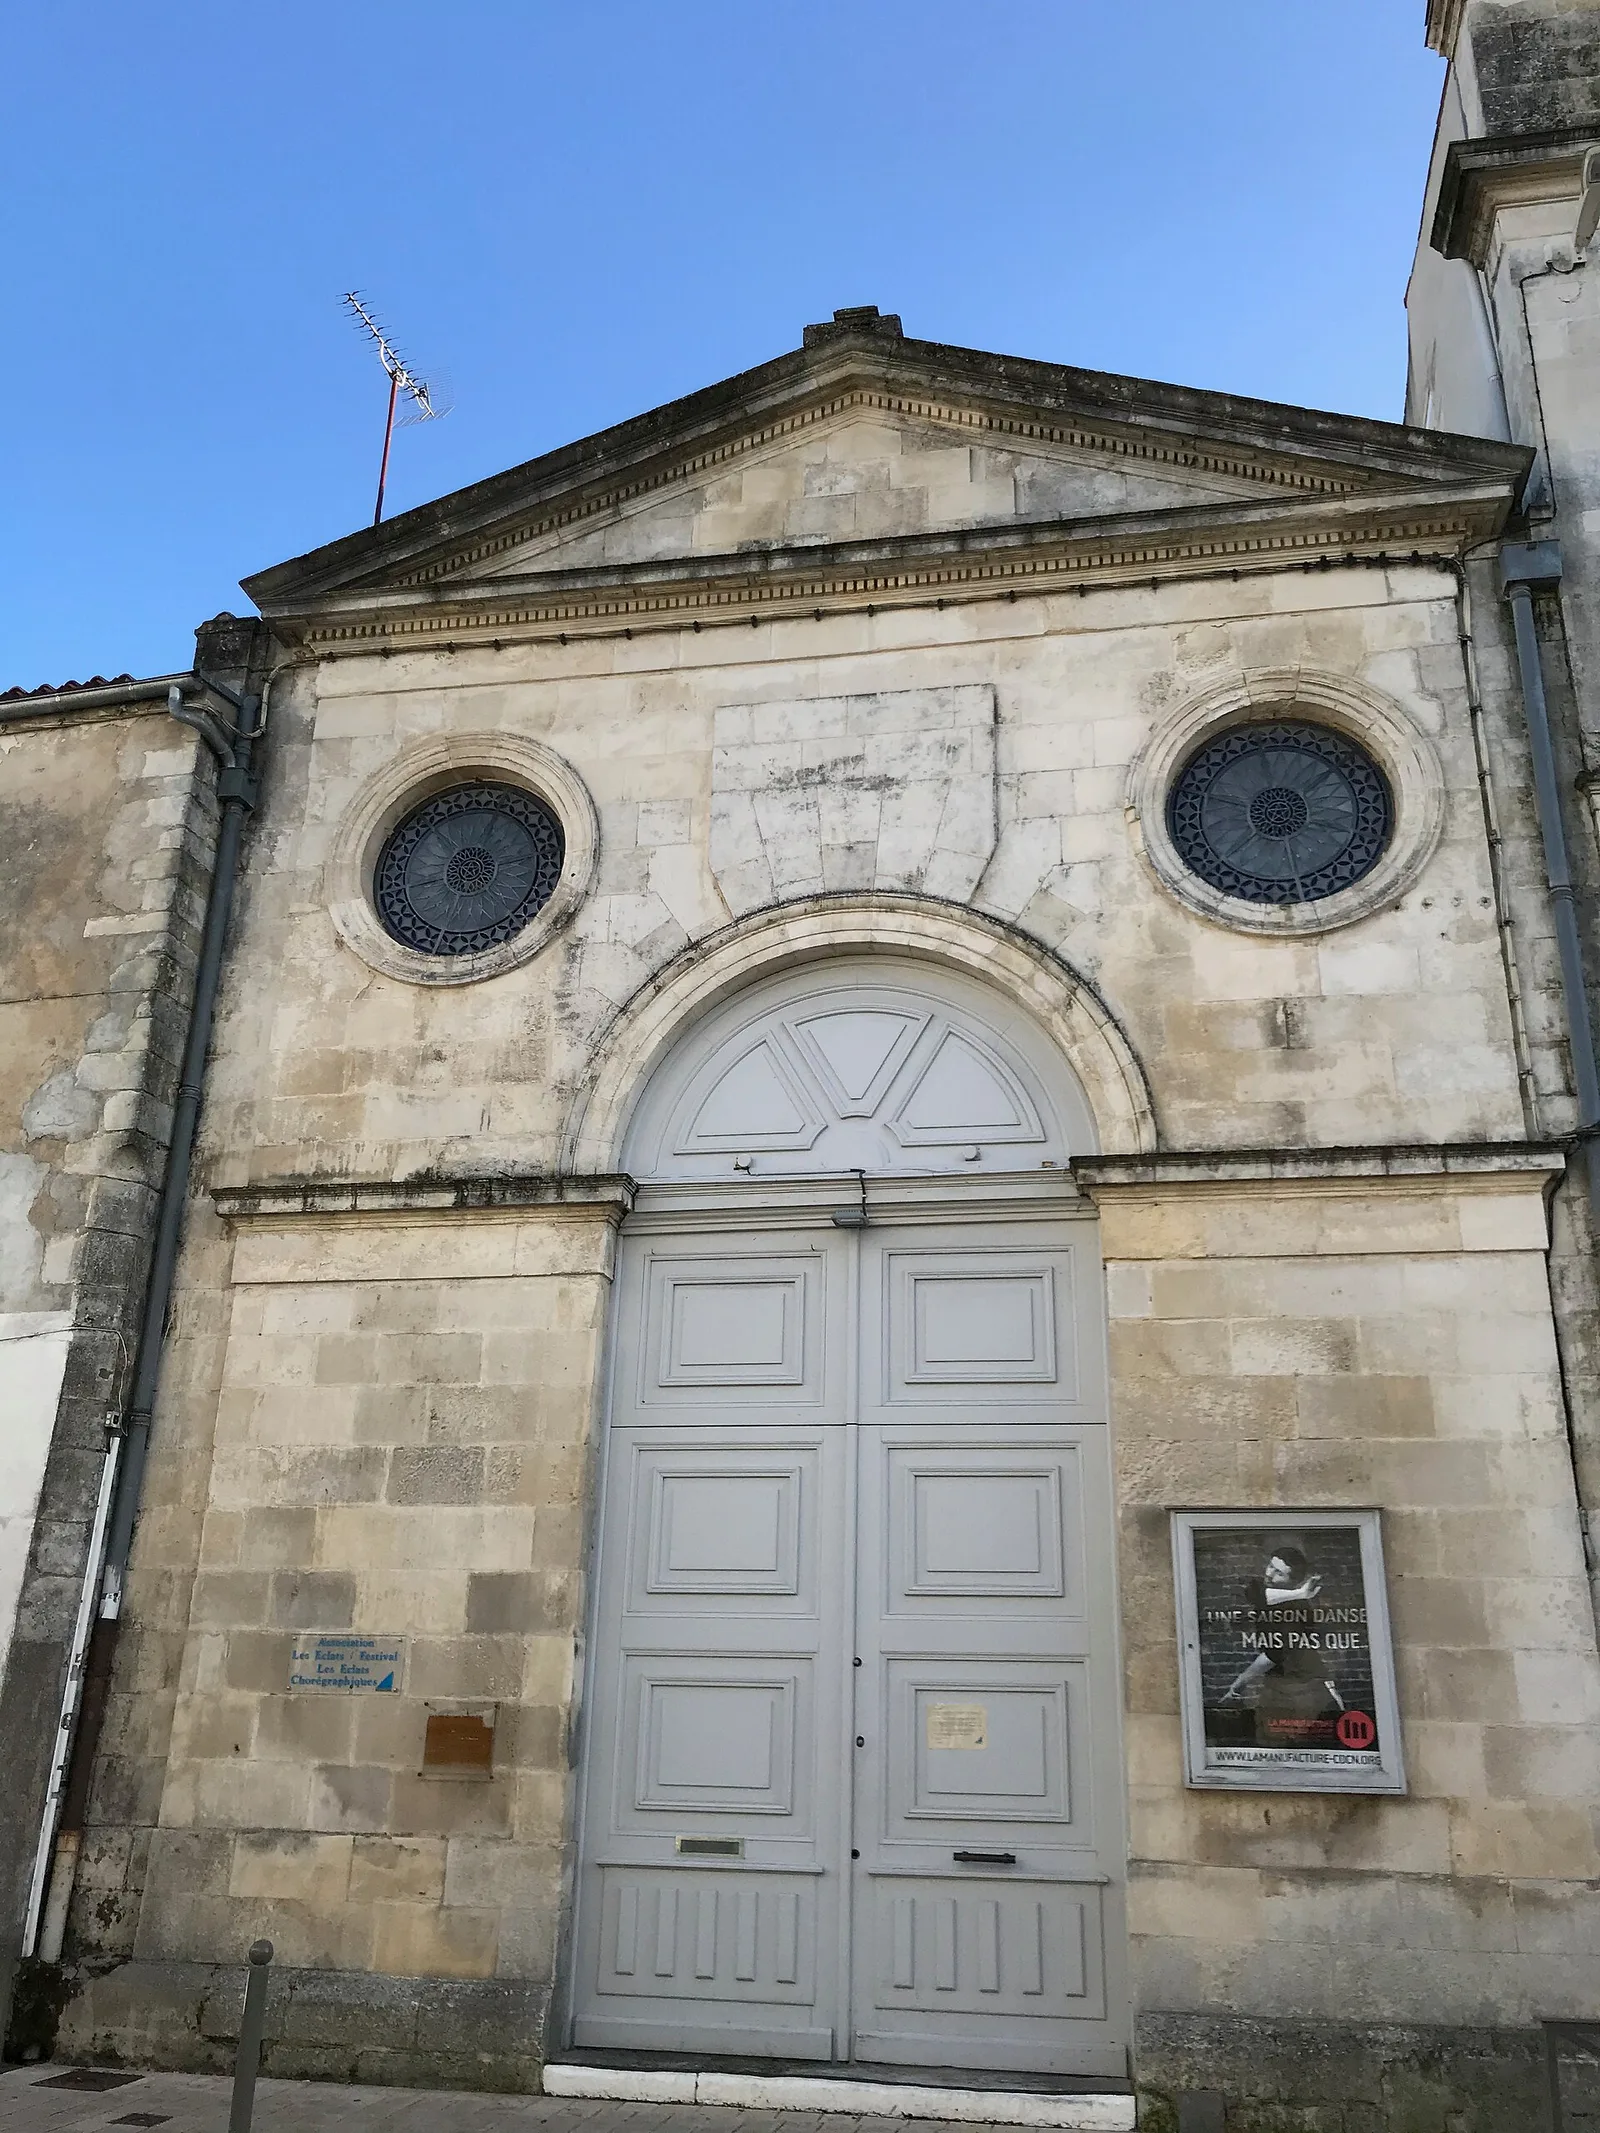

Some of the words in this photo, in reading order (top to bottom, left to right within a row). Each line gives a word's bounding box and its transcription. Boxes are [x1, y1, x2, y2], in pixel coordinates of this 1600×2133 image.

[1207, 1611, 1242, 1624] UNE
[1247, 1609, 1307, 1624] SAISON
[1313, 1608, 1367, 1623] DANSE
[317, 1637, 375, 1648] Association
[1241, 1632, 1283, 1649] MAIS
[1288, 1632, 1320, 1649] PAS
[291, 1650, 310, 1660] Les
[359, 1650, 399, 1661] Festival
[316, 1664, 335, 1674] Les
[290, 1675, 377, 1687] Chorégraphiques
